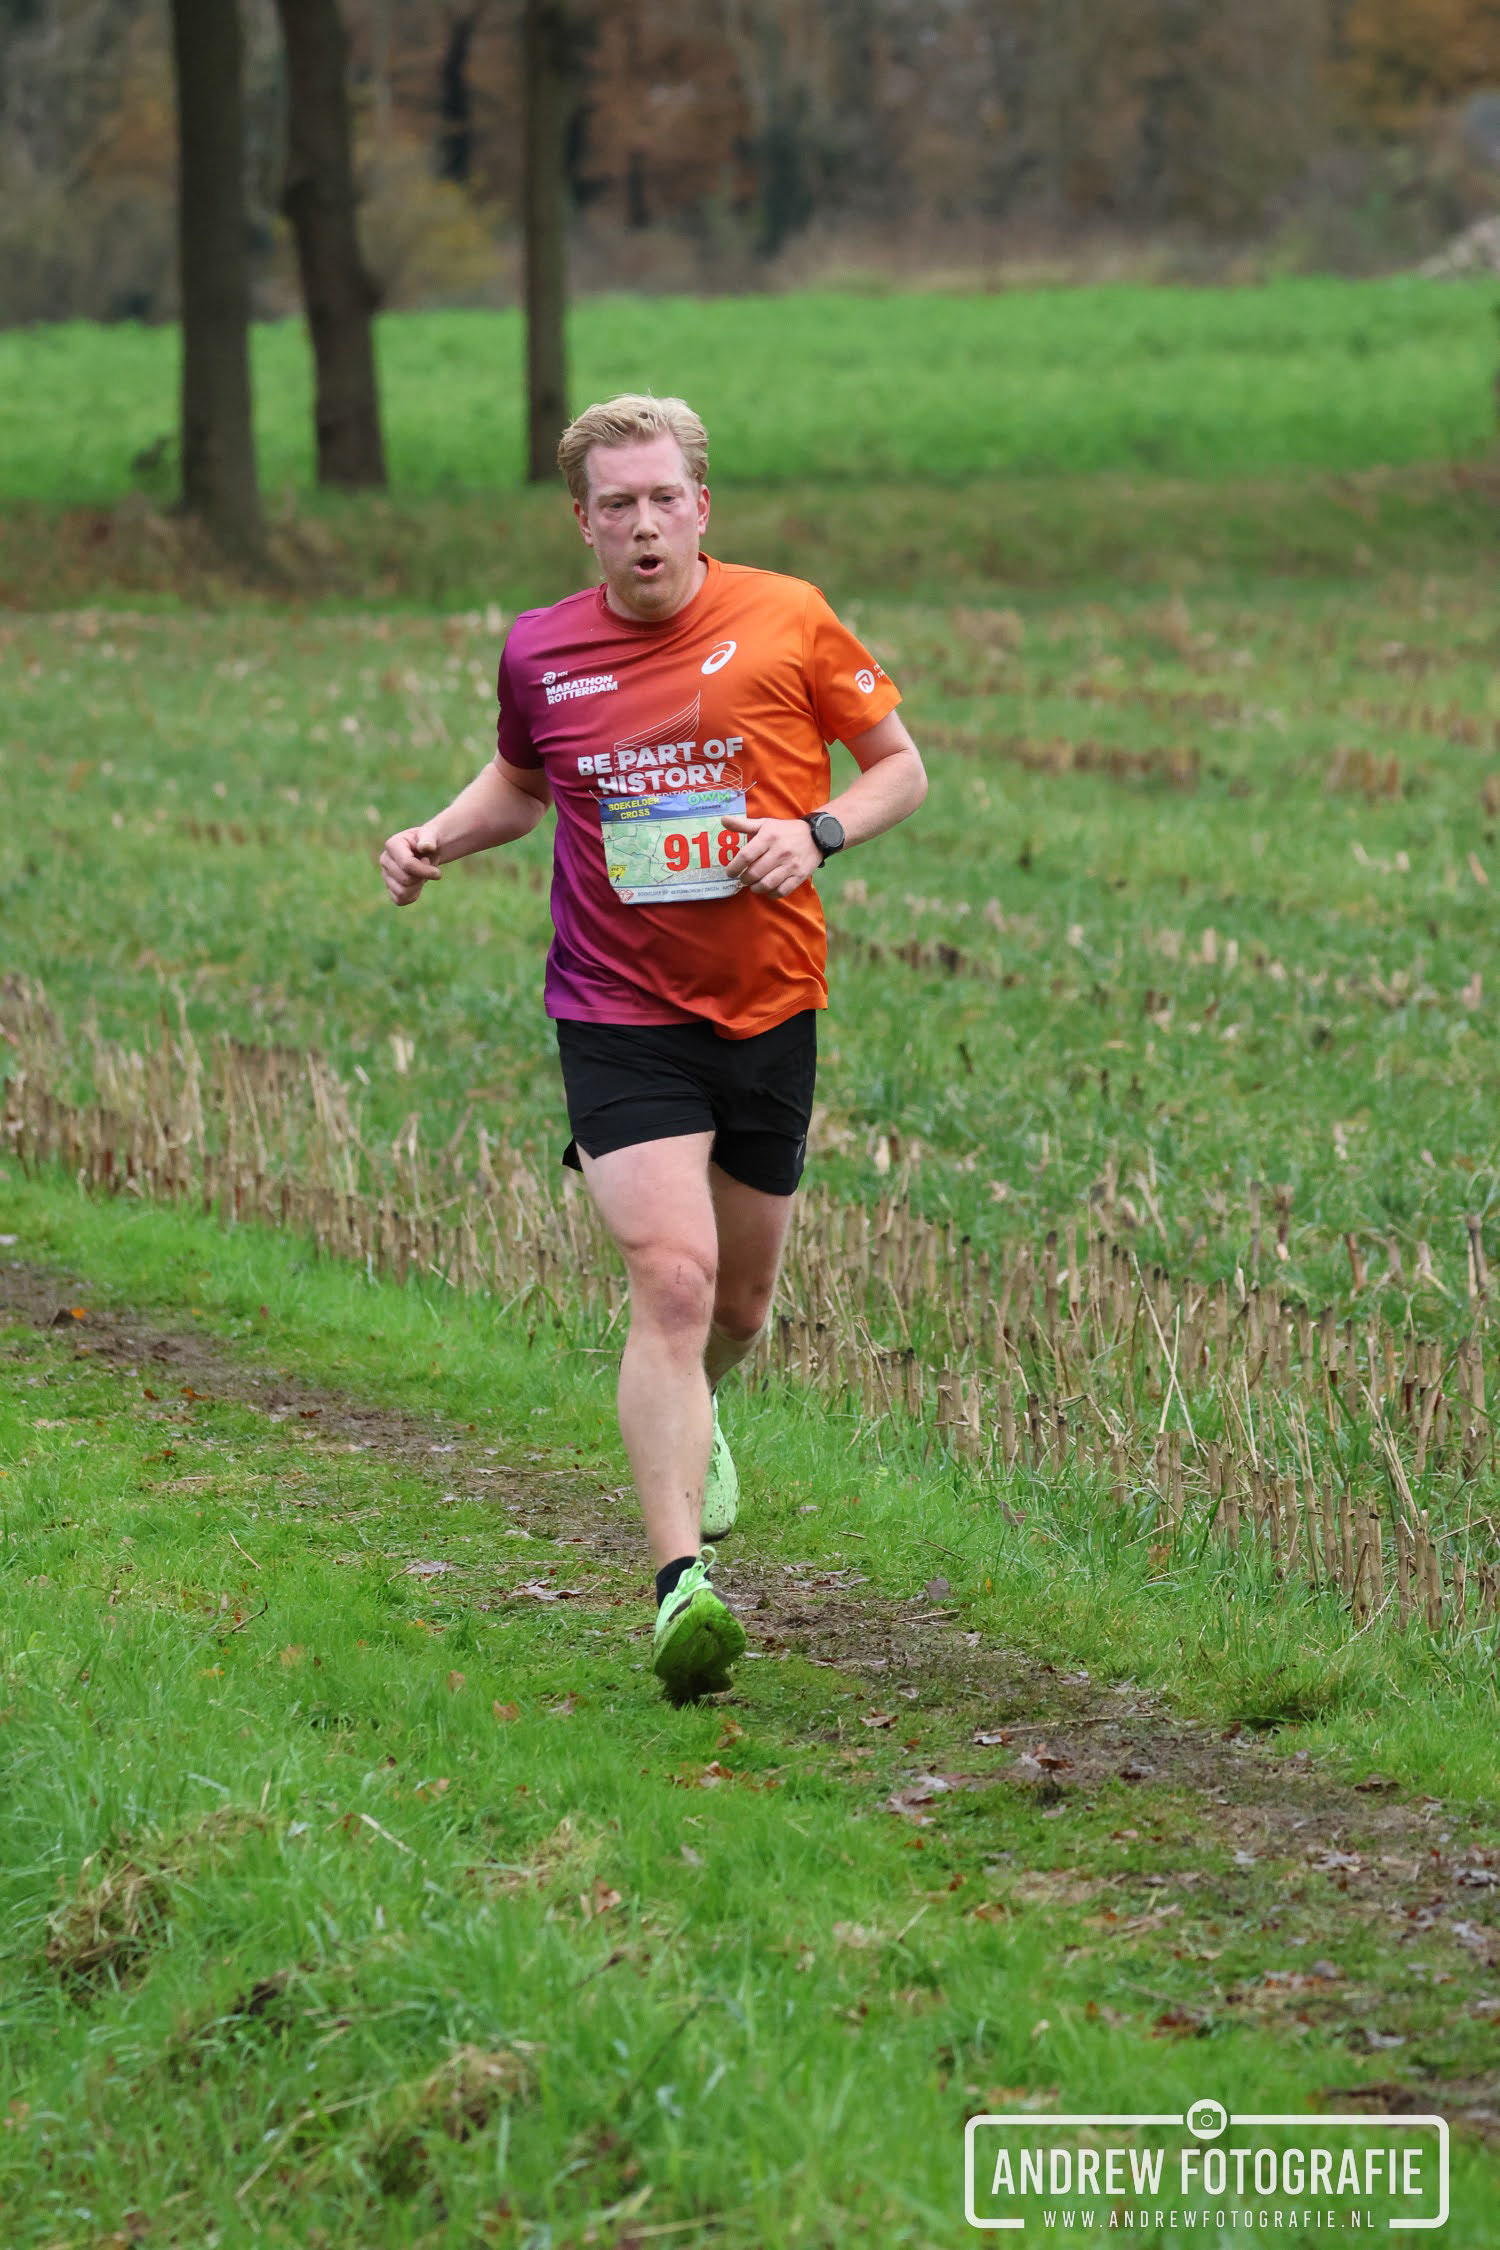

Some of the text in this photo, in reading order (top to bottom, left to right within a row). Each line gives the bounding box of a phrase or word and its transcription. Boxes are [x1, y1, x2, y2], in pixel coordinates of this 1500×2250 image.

[545, 674, 613, 696] MARATHON
[547, 681, 618, 705] ROTTERDAM
[577, 736, 743, 776] BE PART OF
[597, 762, 726, 795] HISTORY
[620, 807, 651, 820] CROSS
[664, 829, 740, 872] 918
